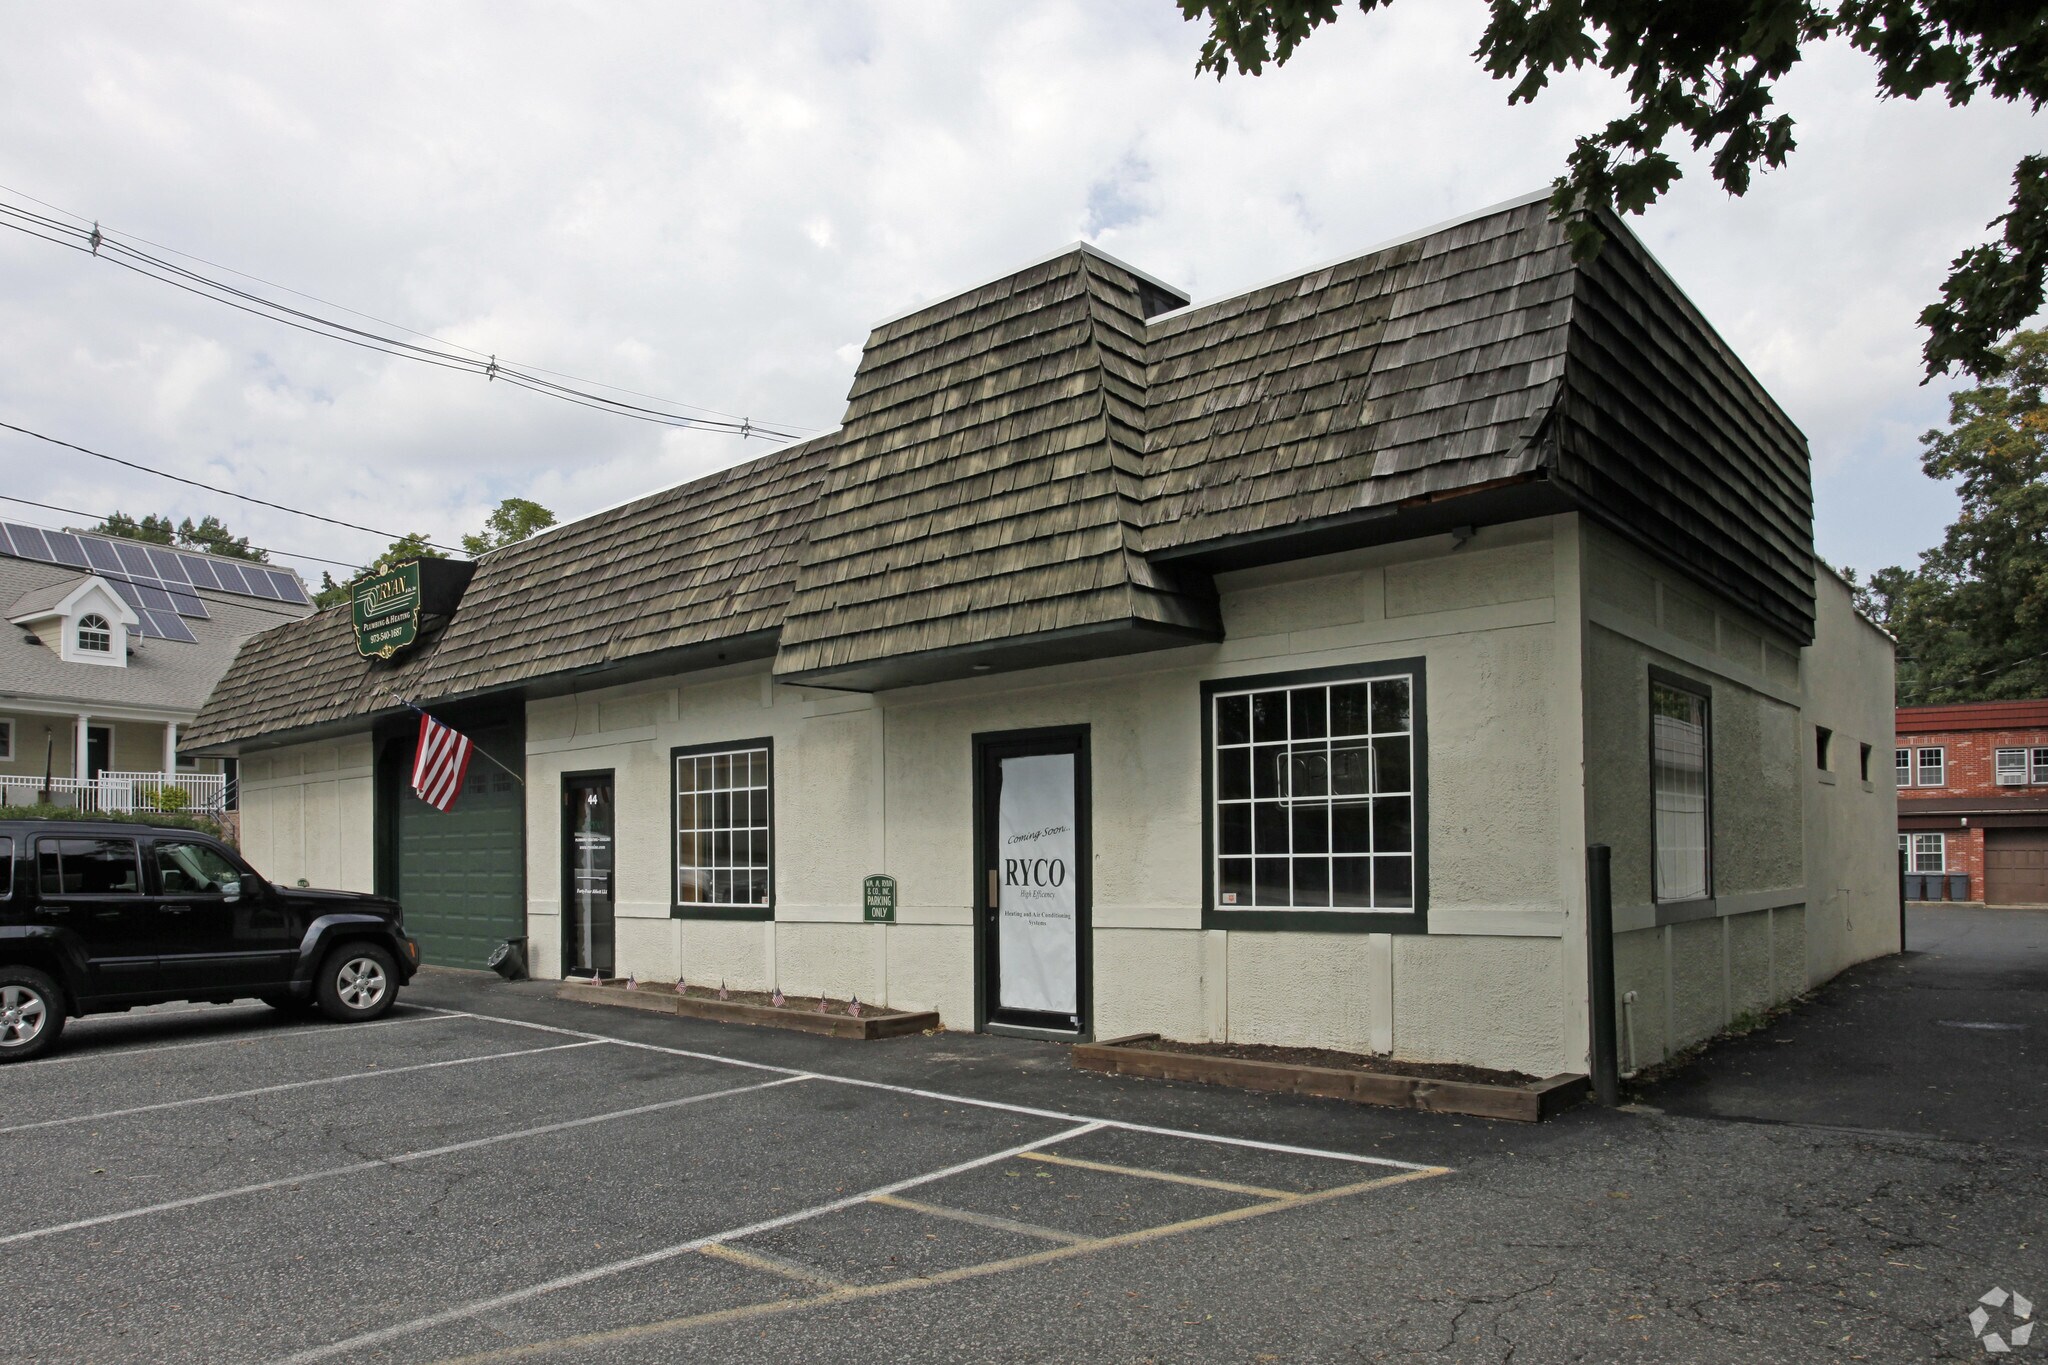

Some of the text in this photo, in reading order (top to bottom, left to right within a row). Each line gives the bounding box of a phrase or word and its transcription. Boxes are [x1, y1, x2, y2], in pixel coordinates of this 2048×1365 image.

[380, 576, 406, 600] RYAN
[363, 619, 386, 632] PLUMBING
[390, 611, 411, 623] HEATING
[587, 794, 598, 805] 44
[1007, 830, 1042, 845] Coming
[1005, 858, 1065, 888] RYCO
[1020, 890, 1032, 899] High
[867, 896, 892, 906] PARKING
[871, 907, 888, 918] ONLY
[1005, 910, 1022, 918] Heating
[1041, 911, 1071, 919] Conditioning
